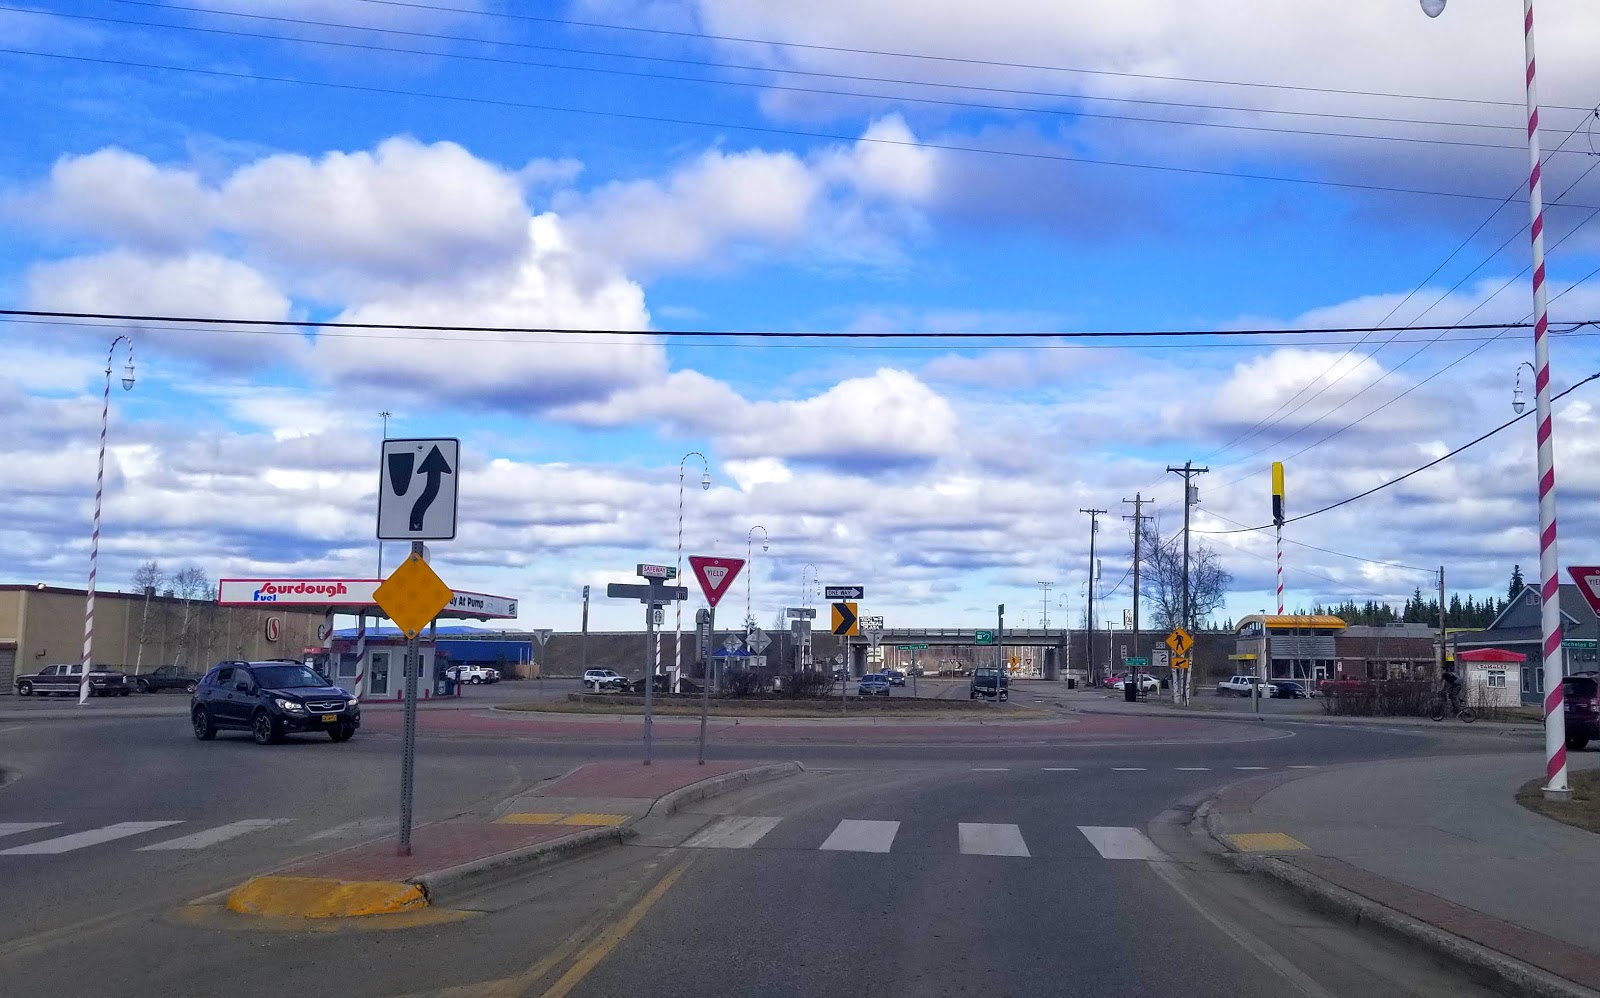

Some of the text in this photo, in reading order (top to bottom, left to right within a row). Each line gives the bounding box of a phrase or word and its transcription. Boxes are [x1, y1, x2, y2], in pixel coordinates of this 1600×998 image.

[643, 565, 666, 573] SAFEWAY
[707, 569, 724, 577] YIELD
[260, 582, 347, 598] Sourdough
[458, 596, 466, 607] At
[467, 597, 484, 609] Pump
[1160, 654, 1167, 663] 2
